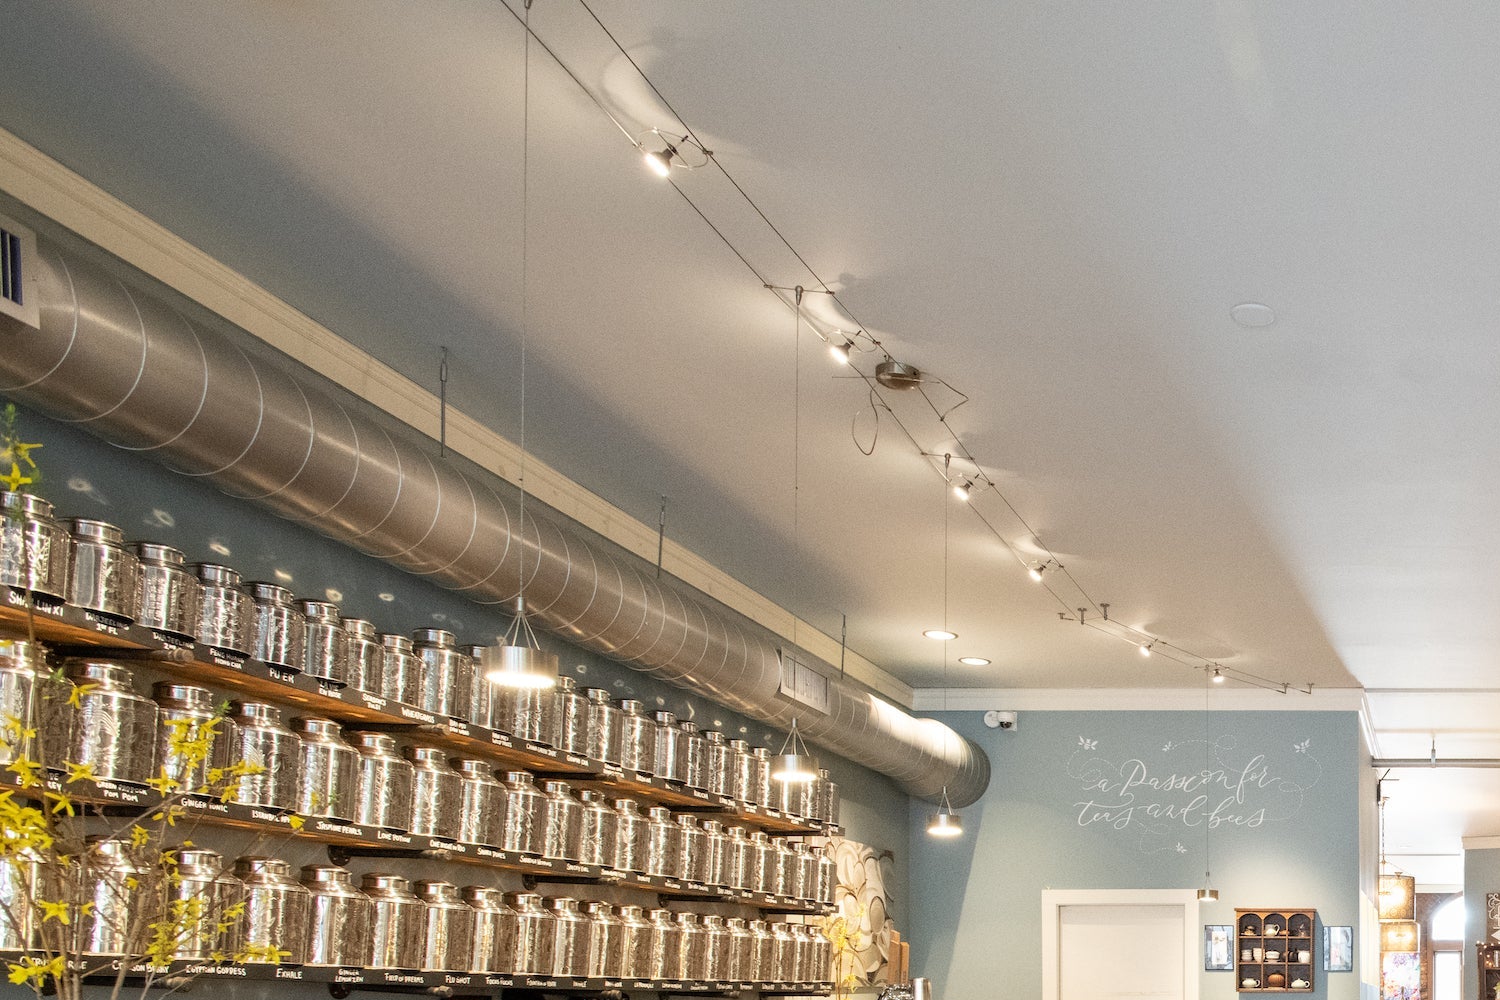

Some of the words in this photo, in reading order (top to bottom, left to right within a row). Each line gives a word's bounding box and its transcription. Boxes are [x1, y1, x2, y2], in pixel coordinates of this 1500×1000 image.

[53, 606, 64, 618] XI
[1237, 755, 1281, 804] for
[1073, 795, 1134, 829] teas
[1138, 795, 1208, 827] and
[1202, 796, 1266, 828] bees
[276, 968, 303, 980] EXHALE
